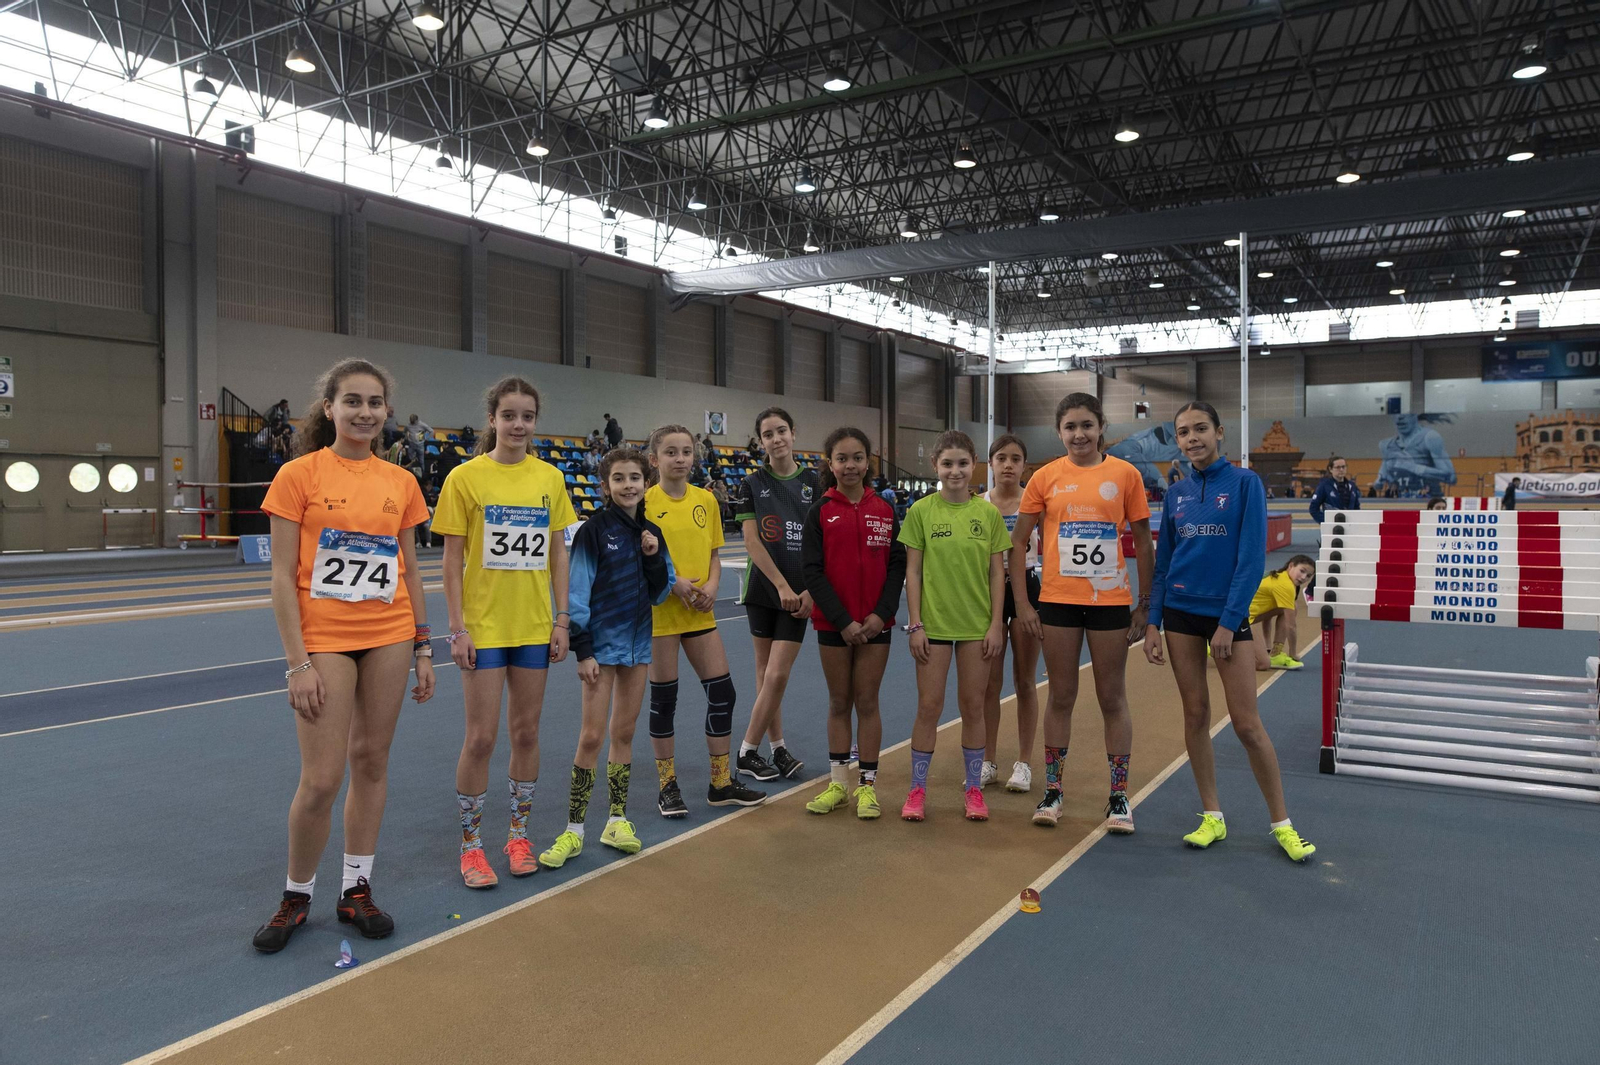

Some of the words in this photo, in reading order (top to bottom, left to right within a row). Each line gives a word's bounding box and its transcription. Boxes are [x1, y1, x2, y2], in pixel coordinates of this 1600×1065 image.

[1565, 350, 1600, 368] OU
[1516, 479, 1600, 494] tletismo.gal
[1438, 514, 1498, 524] MONDO
[785, 521, 804, 531] Sto
[931, 523, 952, 532] OPTI
[786, 531, 803, 540] Sal
[931, 531, 952, 539] PRO
[1436, 527, 1497, 537] MONDO
[490, 531, 545, 557] 342
[1072, 544, 1105, 566] 56
[1436, 554, 1498, 564] MONDO
[322, 558, 391, 589] 274
[1435, 567, 1498, 579] MONDO
[1435, 581, 1498, 592] MONDO
[1433, 595, 1497, 607] MONDO
[1431, 610, 1496, 623] MONDO
